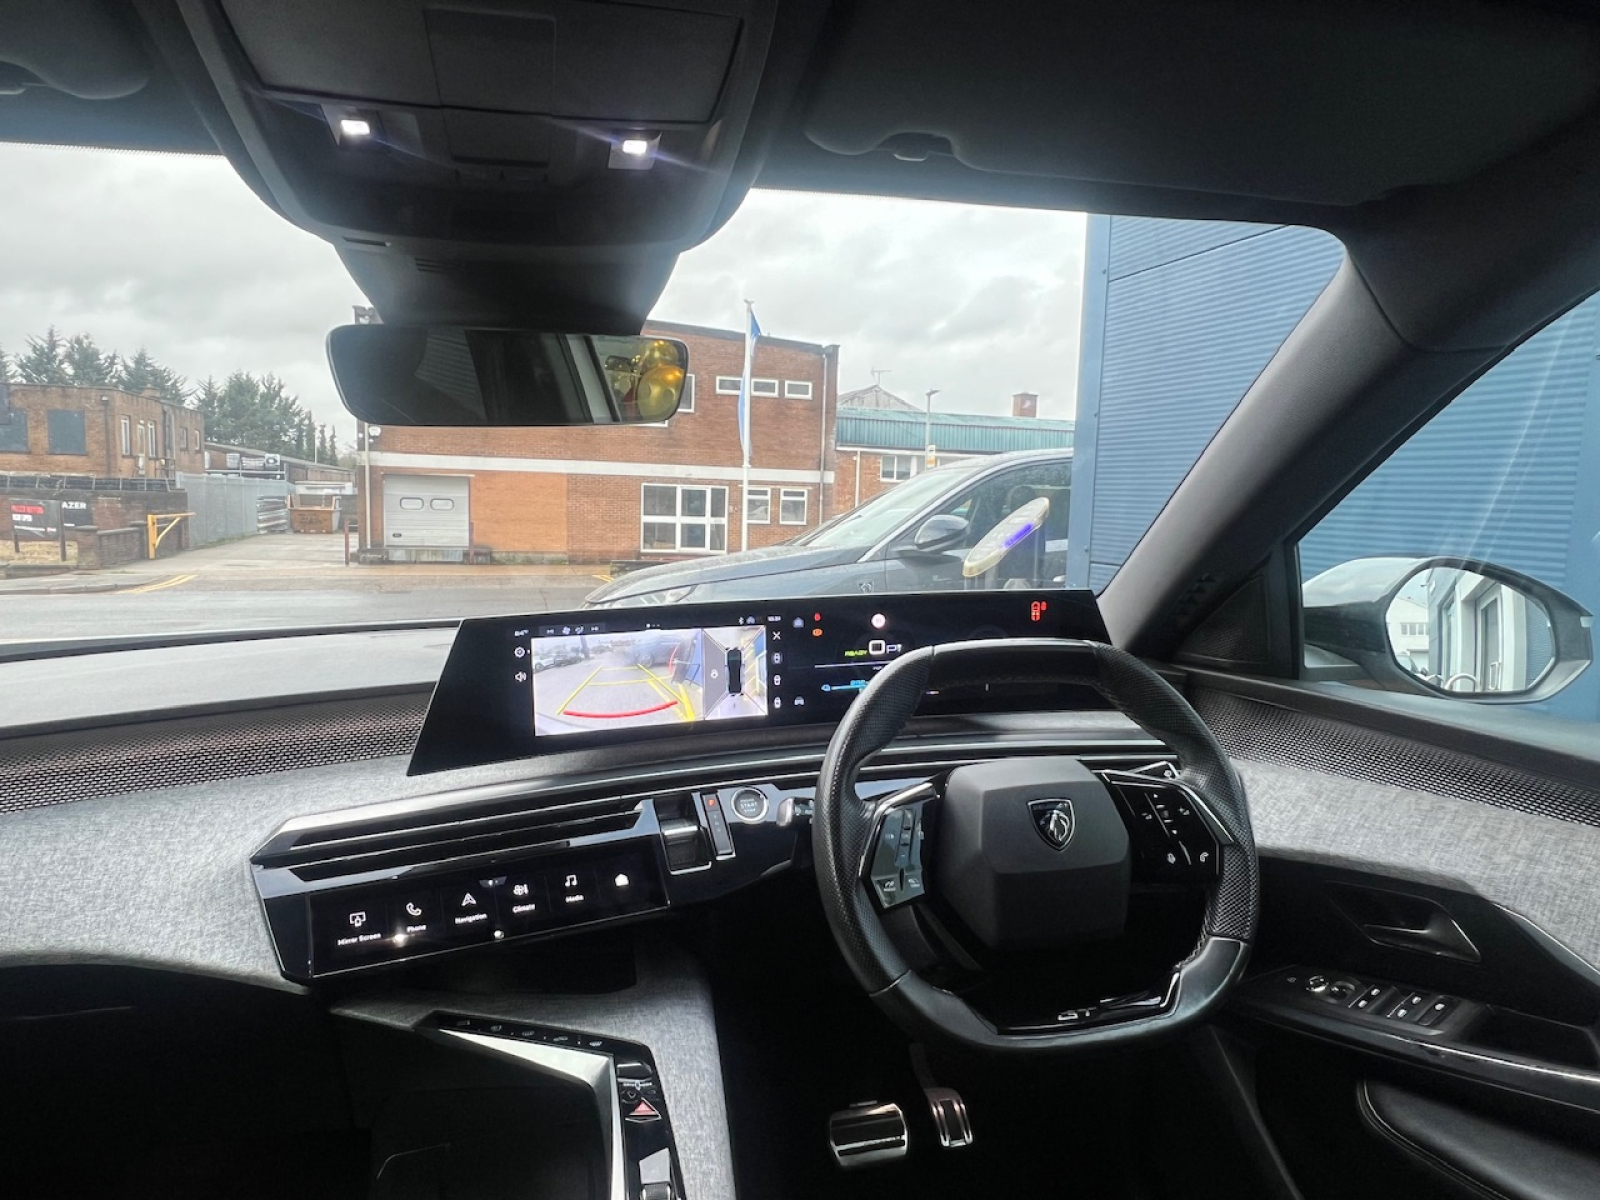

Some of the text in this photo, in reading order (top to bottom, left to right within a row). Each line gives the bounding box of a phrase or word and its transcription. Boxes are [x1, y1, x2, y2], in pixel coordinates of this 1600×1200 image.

[454, 913, 488, 924] Navigation
[406, 924, 427, 933] Phone
[358, 933, 381, 942] Screen
